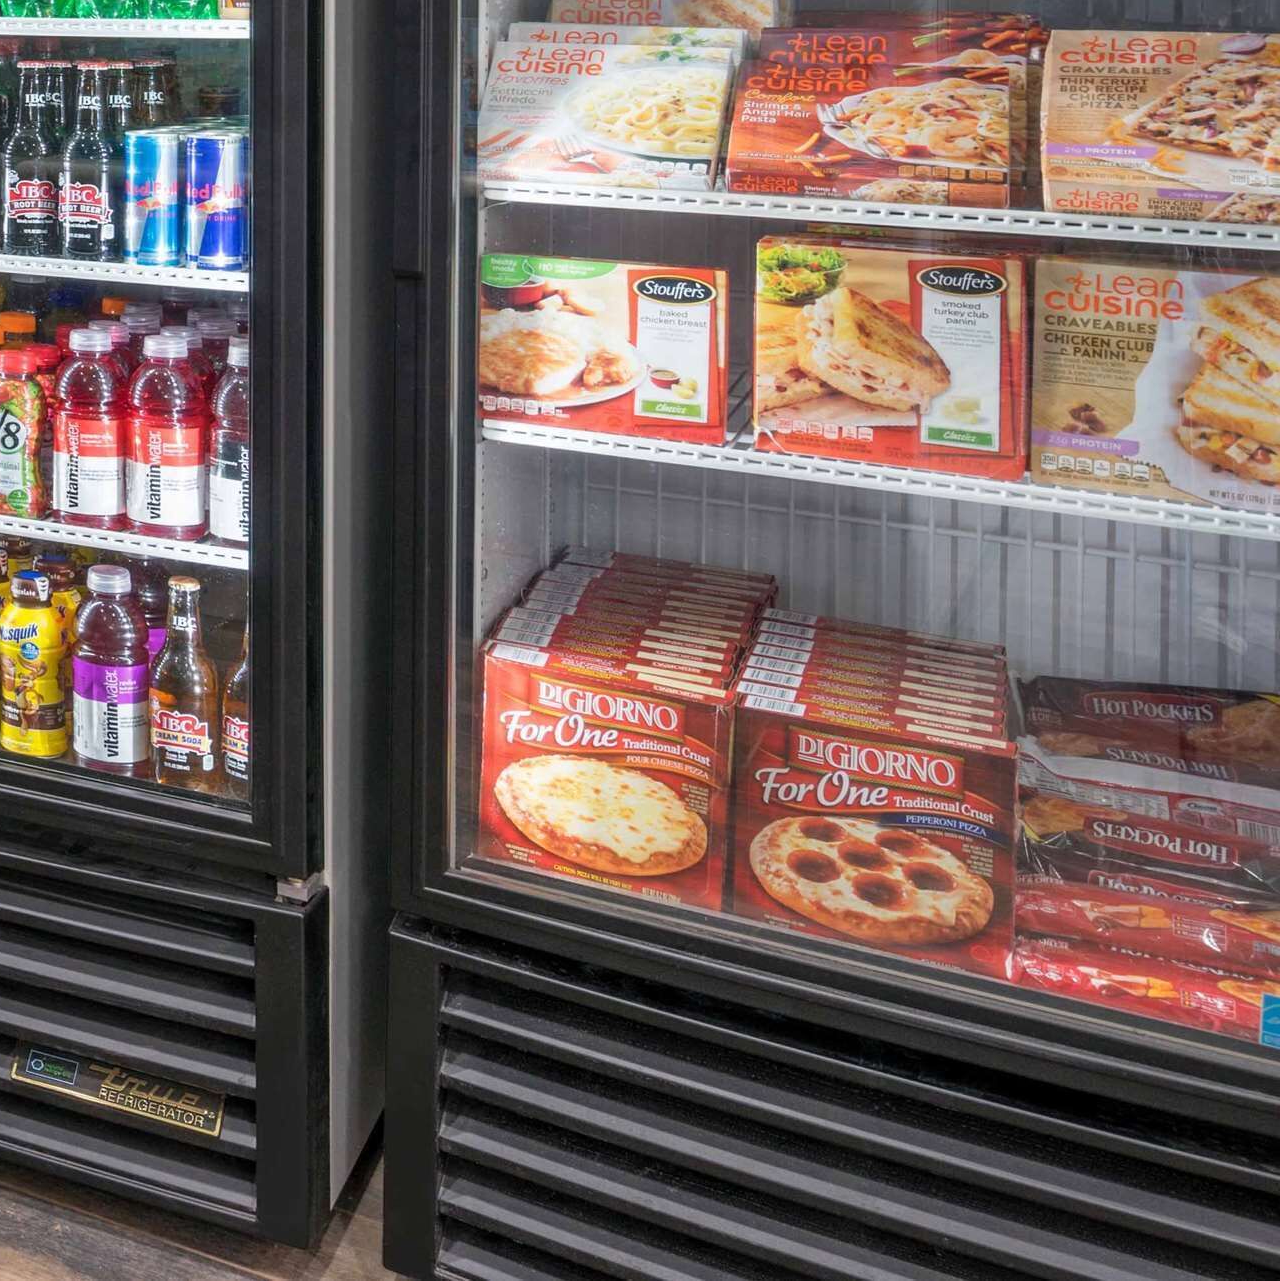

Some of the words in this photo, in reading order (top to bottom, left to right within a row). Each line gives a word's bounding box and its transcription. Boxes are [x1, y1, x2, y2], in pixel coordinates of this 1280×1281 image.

[1059, 66, 1171, 75] CRAVEABLES
[1059, 77, 1095, 85] THIN
[1099, 77, 1149, 86] CRUST
[745, 89, 816, 103] Comfort
[1059, 85, 1091, 94] BBQ
[1095, 85, 1147, 93] RECIPE
[25, 93, 45, 104] IBC
[79, 96, 101, 106] IBC
[109, 95, 131, 105] IBC
[144, 92, 164, 101] IBC
[489, 96, 536, 104] Alfredo
[1069, 92, 1138, 101] CHICKEN
[744, 100, 789, 111] Shrimp
[1080, 101, 1123, 109] PIZZA
[741, 115, 776, 123] Pasta
[743, 107, 780, 116] Angel
[785, 110, 811, 118] Hair
[1085, 148, 1137, 156] PROTEIN
[22, 186, 50, 199] IBC
[68, 189, 94, 202] IBC
[14, 201, 36, 209] ROOT
[80, 204, 103, 214] BEER
[927, 272, 994, 291] Stouffer's
[643, 280, 706, 300] Stouffer's
[941, 301, 981, 311] smoked
[659, 309, 688, 319] baked
[933, 308, 966, 319] turkey
[967, 311, 989, 320] club
[641, 317, 676, 327] chicken
[677, 319, 707, 328] breast
[945, 318, 977, 327] panini
[1044, 315, 1157, 335] CRAVEABLES
[1043, 332, 1111, 348] CHICKEN
[1116, 340, 1153, 353] CLUB
[1073, 348, 1126, 361] PANINI
[1071, 438, 1121, 451] PROTEIN
[68, 422, 81, 508] vitaminwater
[147, 431, 162, 520] vitaminwater
[173, 616, 197, 628] IBC
[538, 682, 678, 731] DIGIORNO
[1093, 697, 1131, 716] HOT
[1133, 700, 1214, 722] POCKETS
[104, 669, 119, 758] vitaminwater
[162, 715, 193, 732] IBC
[500, 710, 552, 744] For
[554, 715, 618, 748] One
[156, 732, 179, 742] CREAM
[181, 735, 202, 745] SODA
[622, 738, 681, 755] Traditional
[682, 747, 711, 767] Crust
[797, 733, 956, 788] DIGIORNO
[626, 755, 649, 765] FOUR
[650, 756, 683, 771] CHEESE
[684, 762, 710, 780] PIZZA
[755, 768, 814, 805] For
[817, 771, 888, 807] One
[893, 795, 959, 814] Traditional
[962, 803, 994, 824] Crust
[905, 814, 957, 830] PEPPERONI
[958, 821, 987, 837] PIZZA
[1093, 821, 1181, 854] POCKETS
[1186, 841, 1229, 864] HOT
[99, 1087, 205, 1128] REFRIGERATOR
